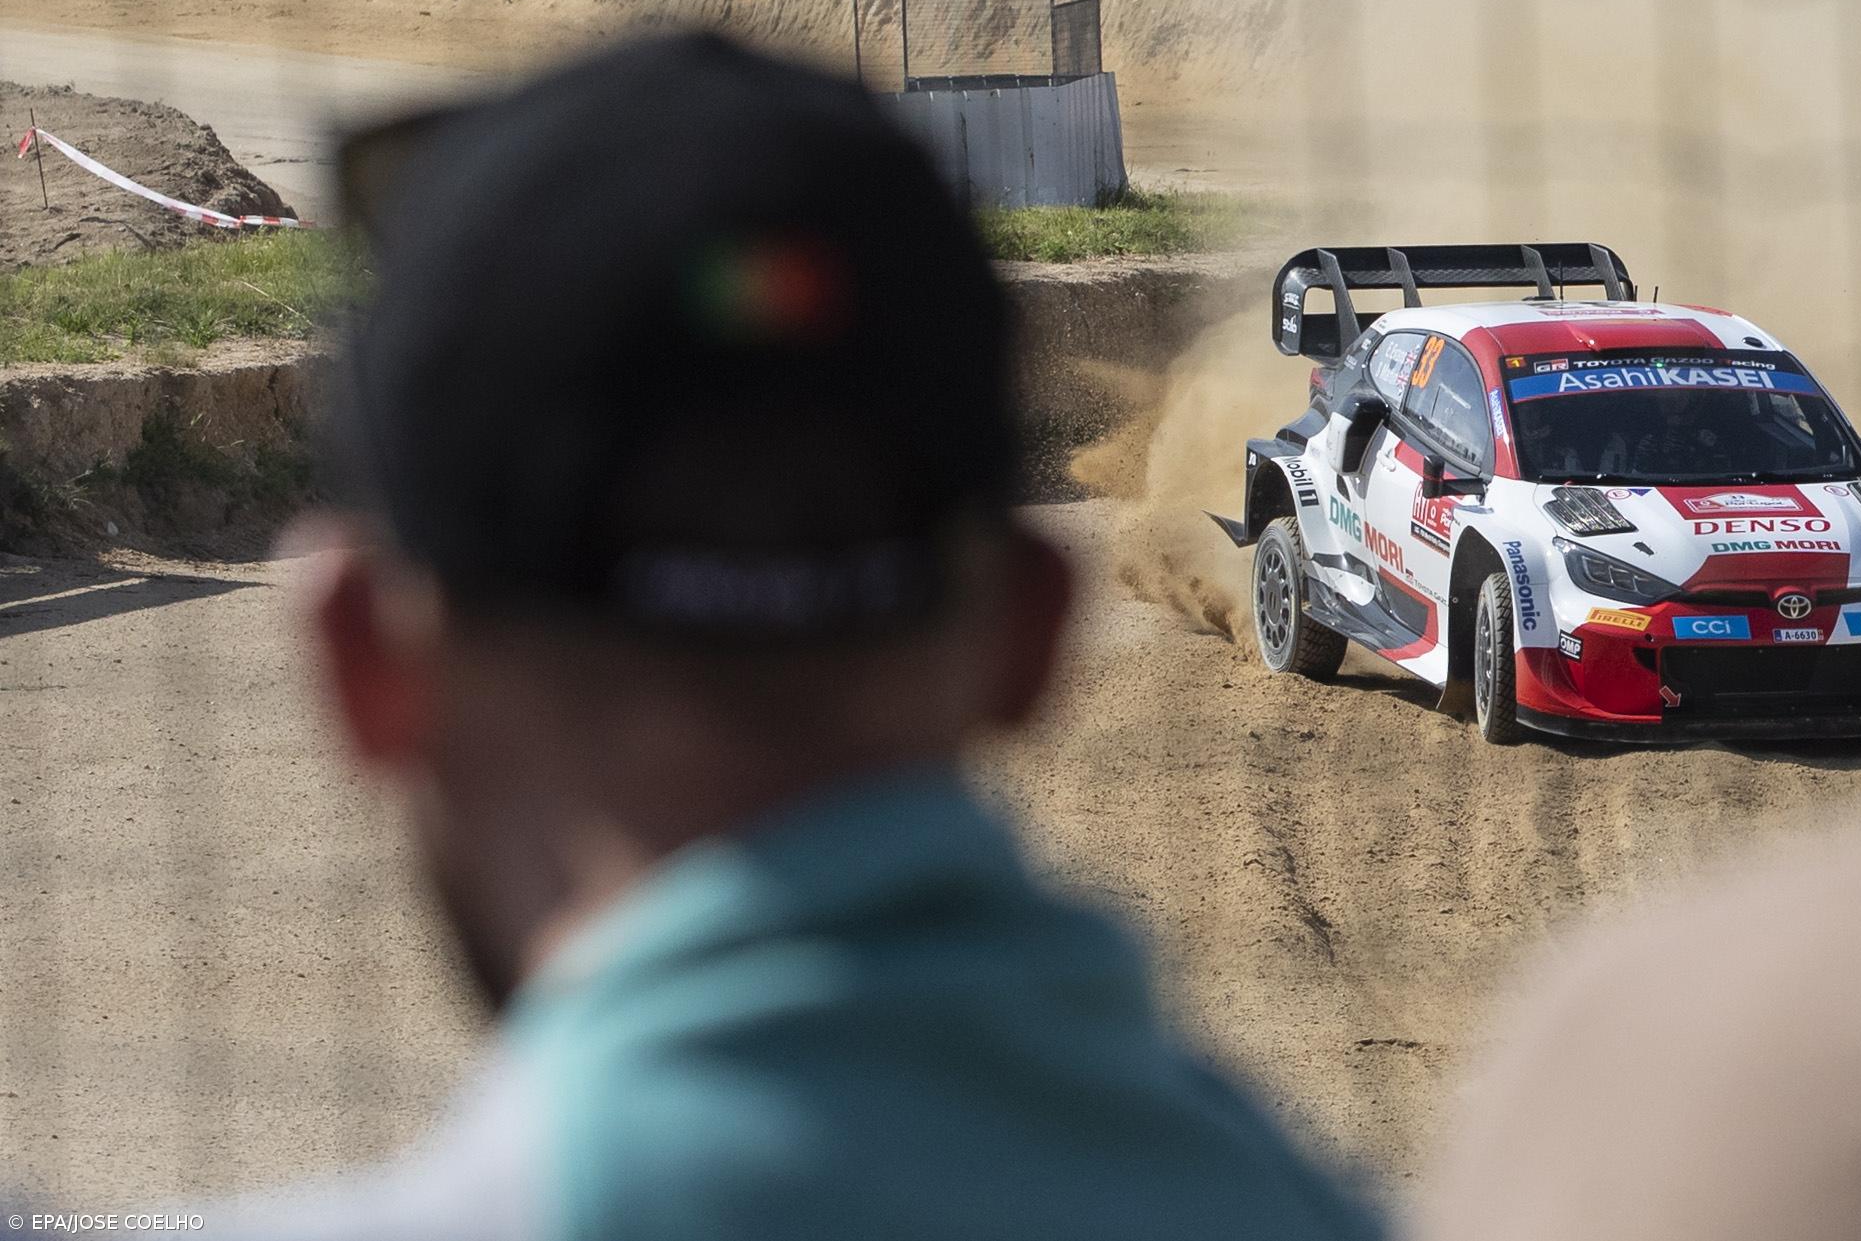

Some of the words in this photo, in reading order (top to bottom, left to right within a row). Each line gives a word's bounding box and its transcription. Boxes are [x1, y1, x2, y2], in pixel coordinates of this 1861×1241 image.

[1411, 336, 1446, 388] 33
[1536, 361, 1568, 372] GR
[1573, 357, 1646, 369] TOYOTA
[1328, 495, 1362, 543] DMG
[1364, 520, 1404, 574] MORI
[1694, 519, 1832, 535] DENSO
[1711, 543, 1772, 553] DMG
[1775, 540, 1841, 551] MORI
[1503, 540, 1541, 632] Panasonic
[1591, 609, 1645, 628] PIRELLI
[1784, 629, 1817, 640] A-6630
[1560, 636, 1582, 656] OMP
